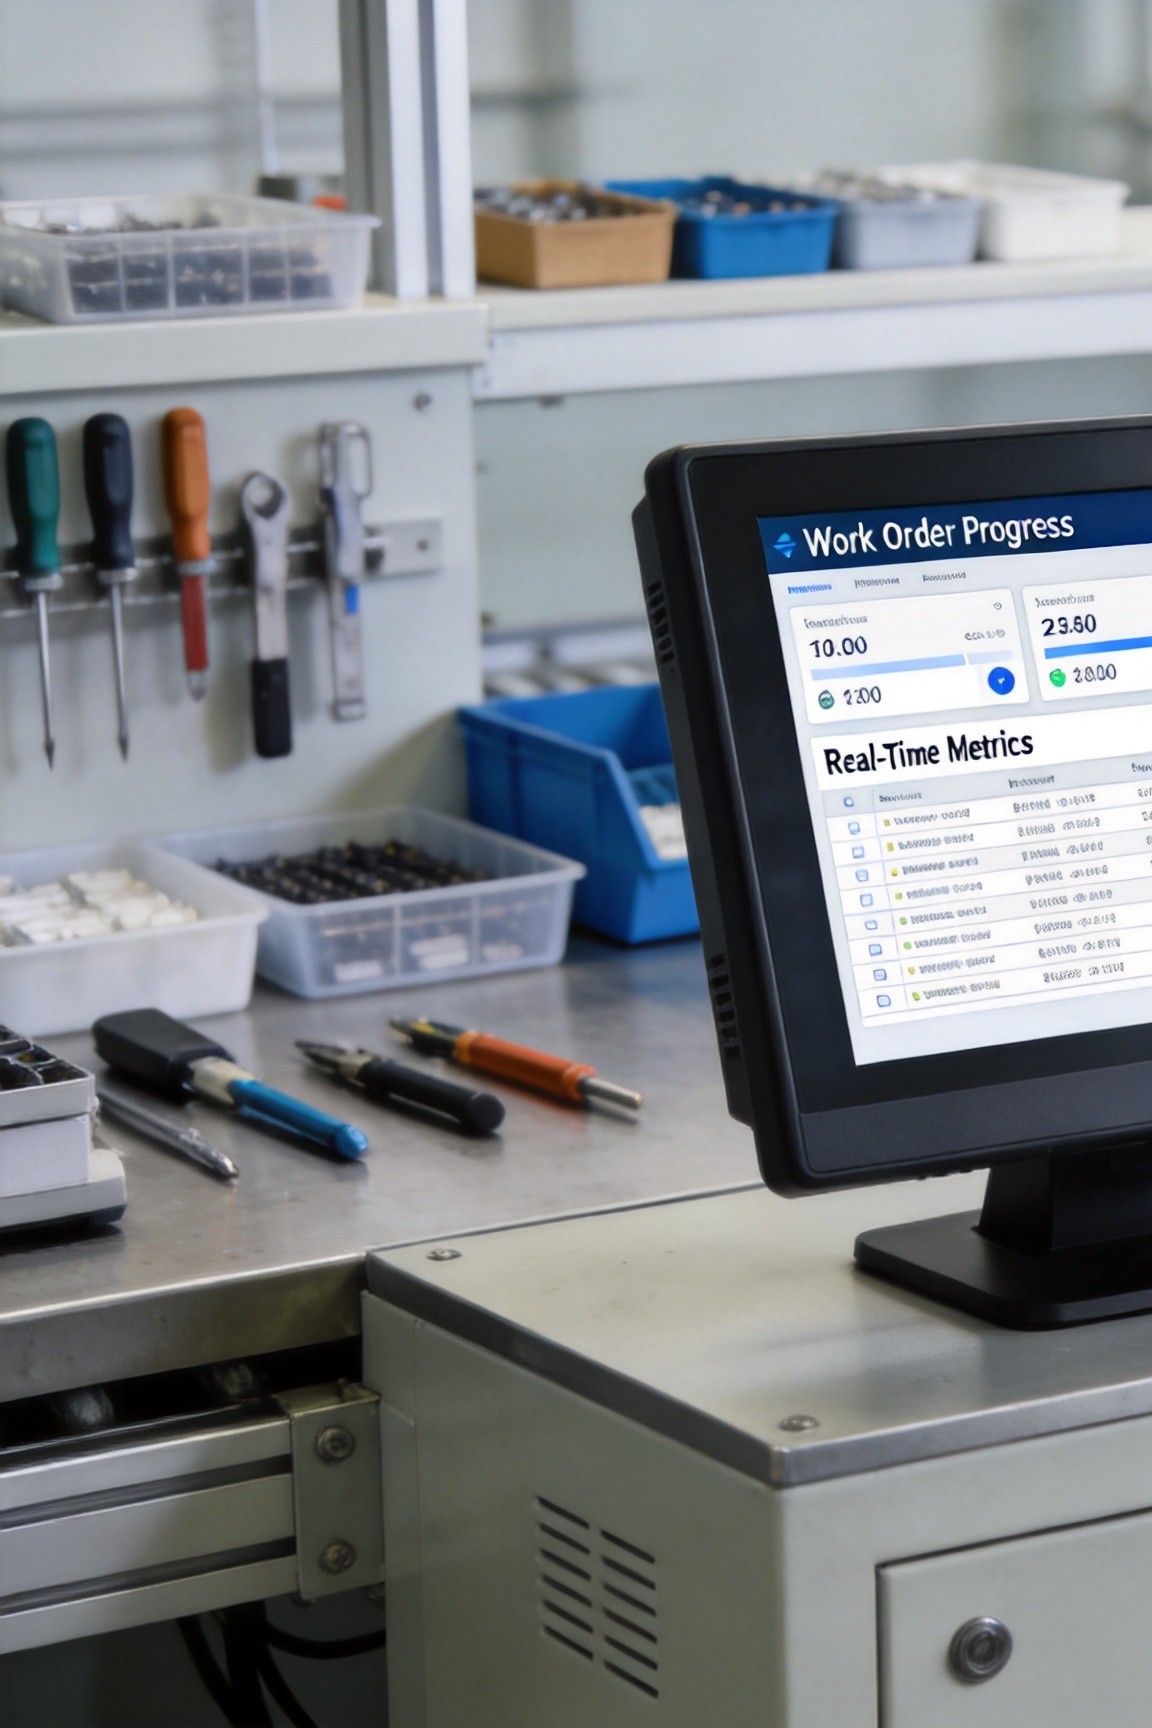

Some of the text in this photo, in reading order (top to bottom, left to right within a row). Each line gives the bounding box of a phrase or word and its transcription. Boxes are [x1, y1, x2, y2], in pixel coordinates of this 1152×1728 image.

[803, 515, 1075, 557] Work Order Progress
[809, 635, 868, 658] 10.00
[823, 729, 1034, 775] Real-Time Metrics
